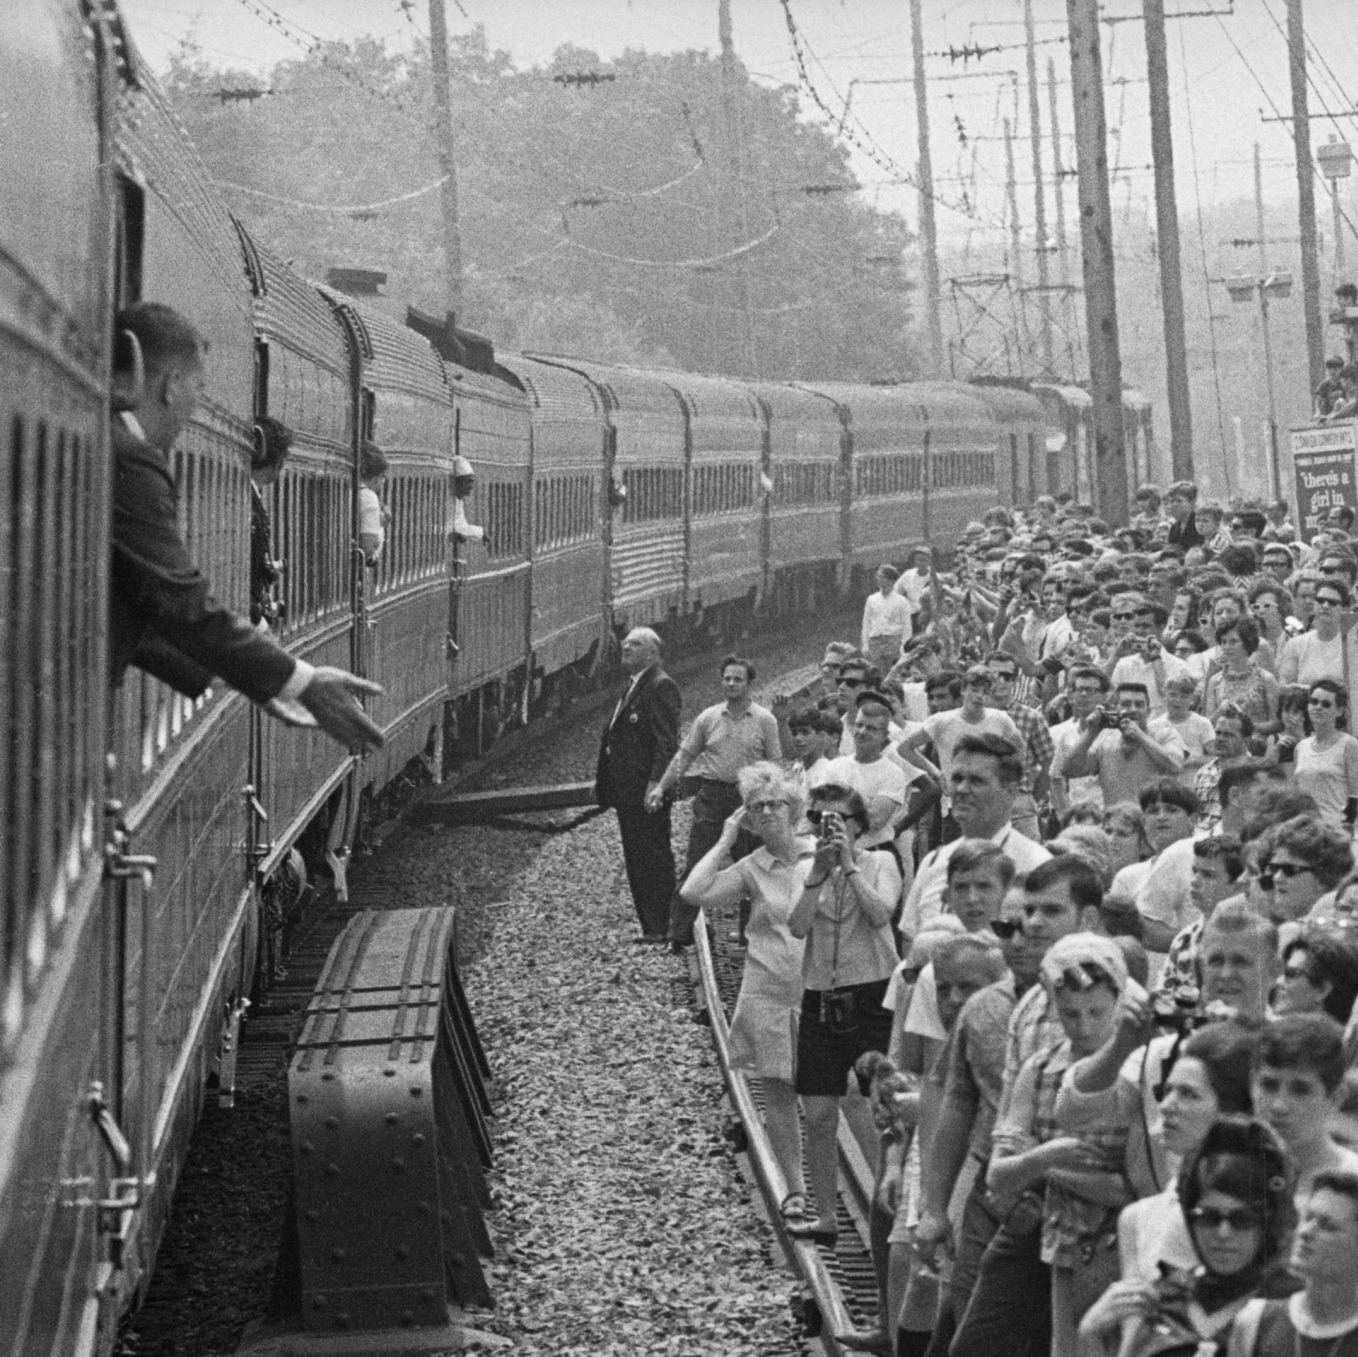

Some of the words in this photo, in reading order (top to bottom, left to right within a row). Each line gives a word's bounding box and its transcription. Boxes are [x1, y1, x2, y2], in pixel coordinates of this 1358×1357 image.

[1341, 472, 1349, 485] a
[1311, 490, 1330, 514] girl
[1331, 489, 1345, 507] in
